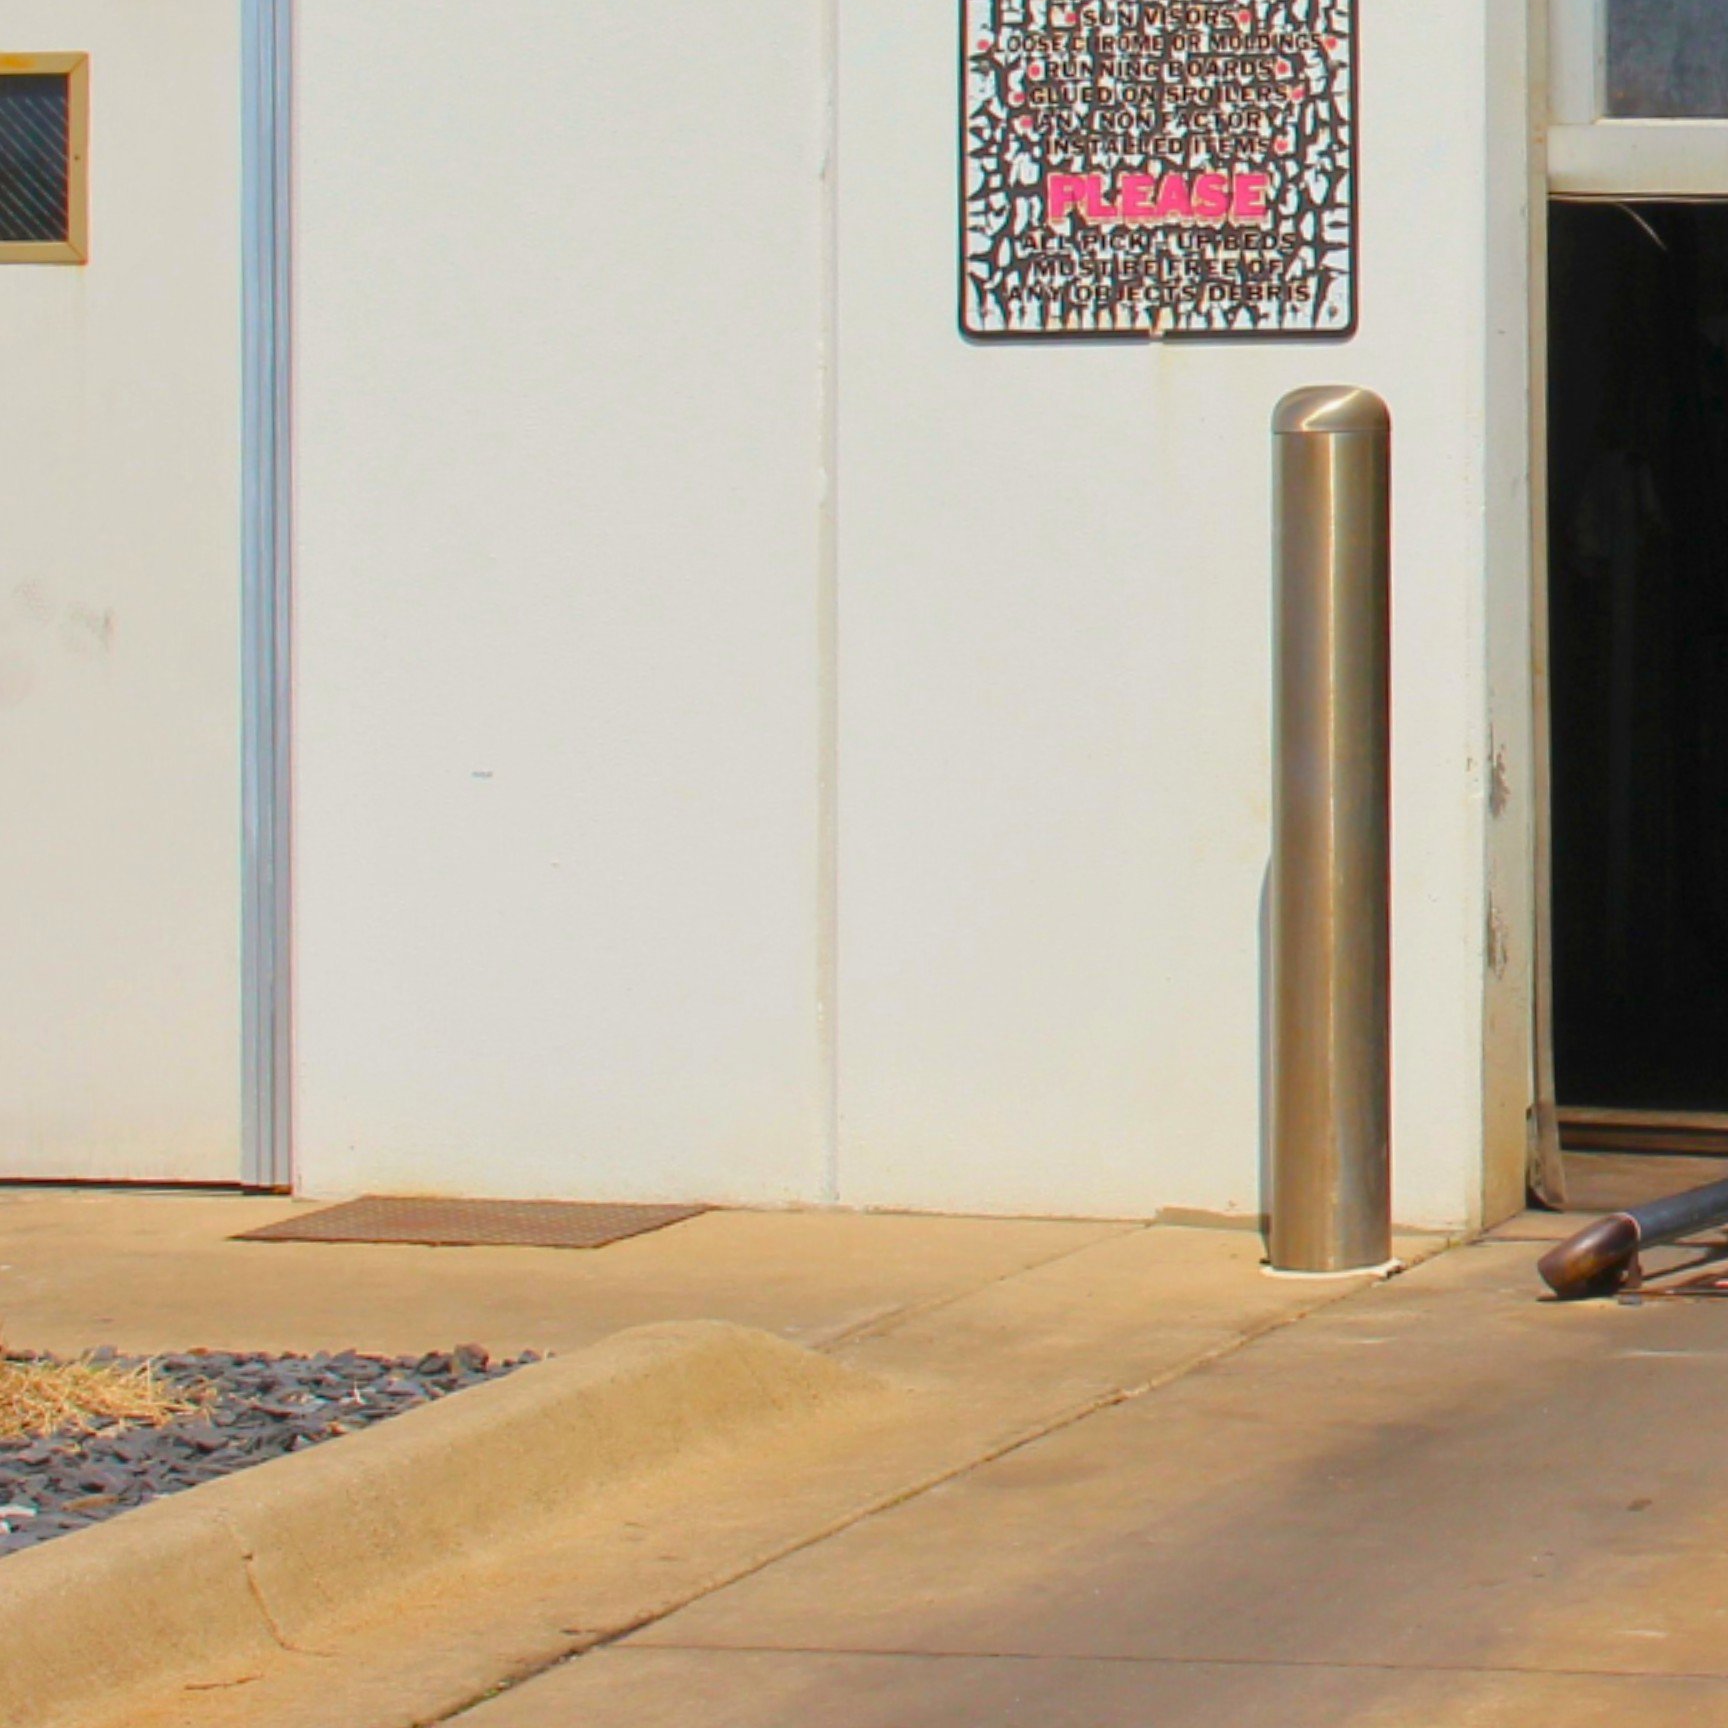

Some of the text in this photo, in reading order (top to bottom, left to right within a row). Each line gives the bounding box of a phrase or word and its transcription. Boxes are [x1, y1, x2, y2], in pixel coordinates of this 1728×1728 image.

[1082, 8, 1235, 26] SUN VISORS
[994, 35, 1062, 53] LOOSE
[1172, 35, 1199, 52] OR
[1209, 34, 1322, 51] MOLDINGS
[1047, 61, 1274, 79] RUNNING BOARDS
[1030, 85, 1288, 104] GLUED ON SPOILERS
[1036, 111, 1281, 130] ANY NON FACTORY
[1046, 136, 1270, 155] INSTALLED ITEMS
[1048, 173, 1269, 219] PLEASE
[1022, 233, 1073, 251] ALL
[1218, 232, 1298, 250] BEDS
[1033, 259, 1283, 276] MUST BE FREE OF
[1007, 284, 1311, 302] ANY OBJECTS DEBRIS
